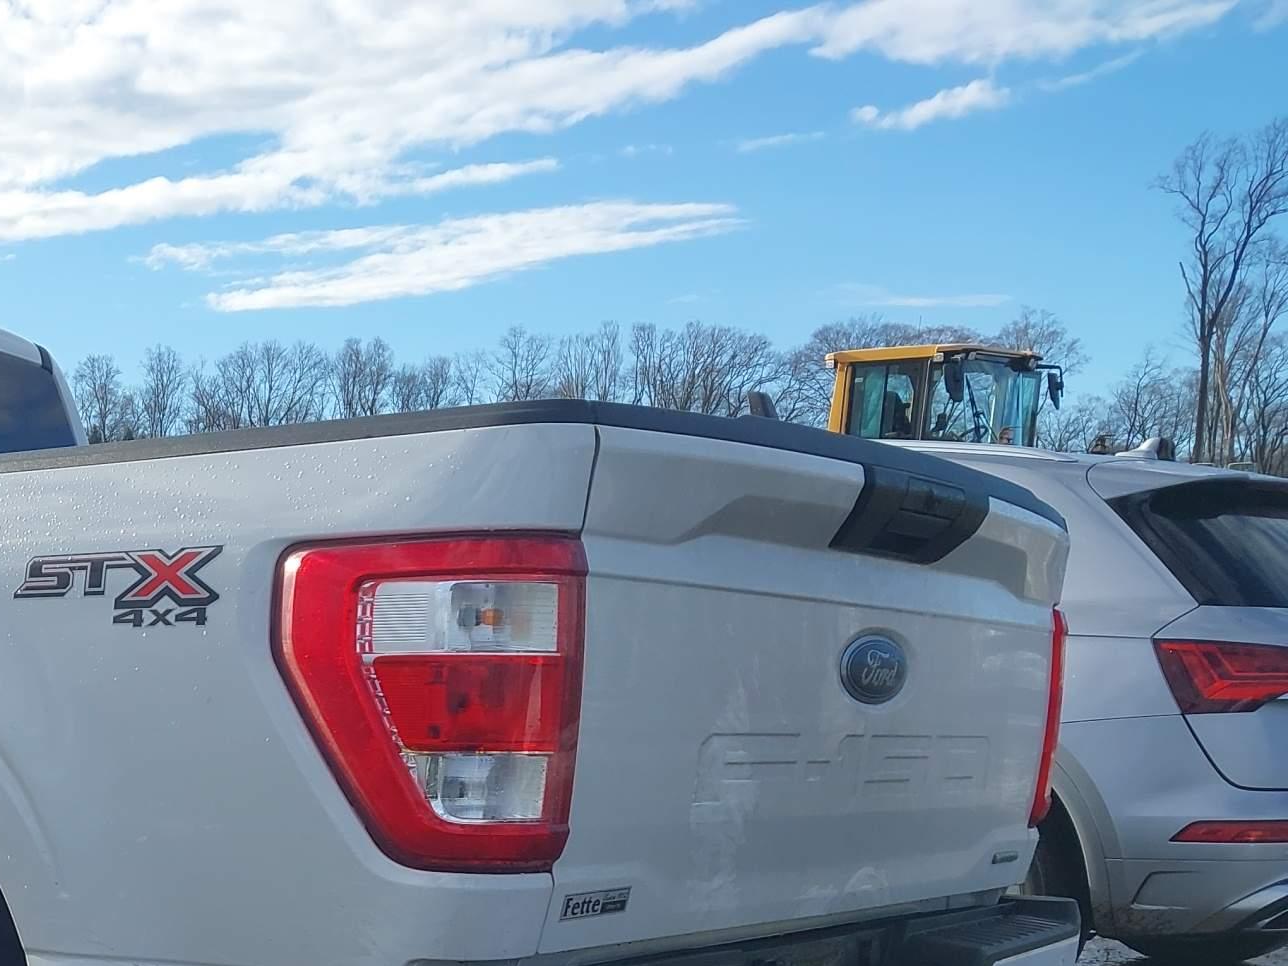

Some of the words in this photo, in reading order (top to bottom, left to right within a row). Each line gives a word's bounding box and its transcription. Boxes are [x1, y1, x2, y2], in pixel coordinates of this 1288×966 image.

[14, 545, 223, 609] STX
[862, 649, 899, 687] Ford
[563, 897, 601, 917] Fette
